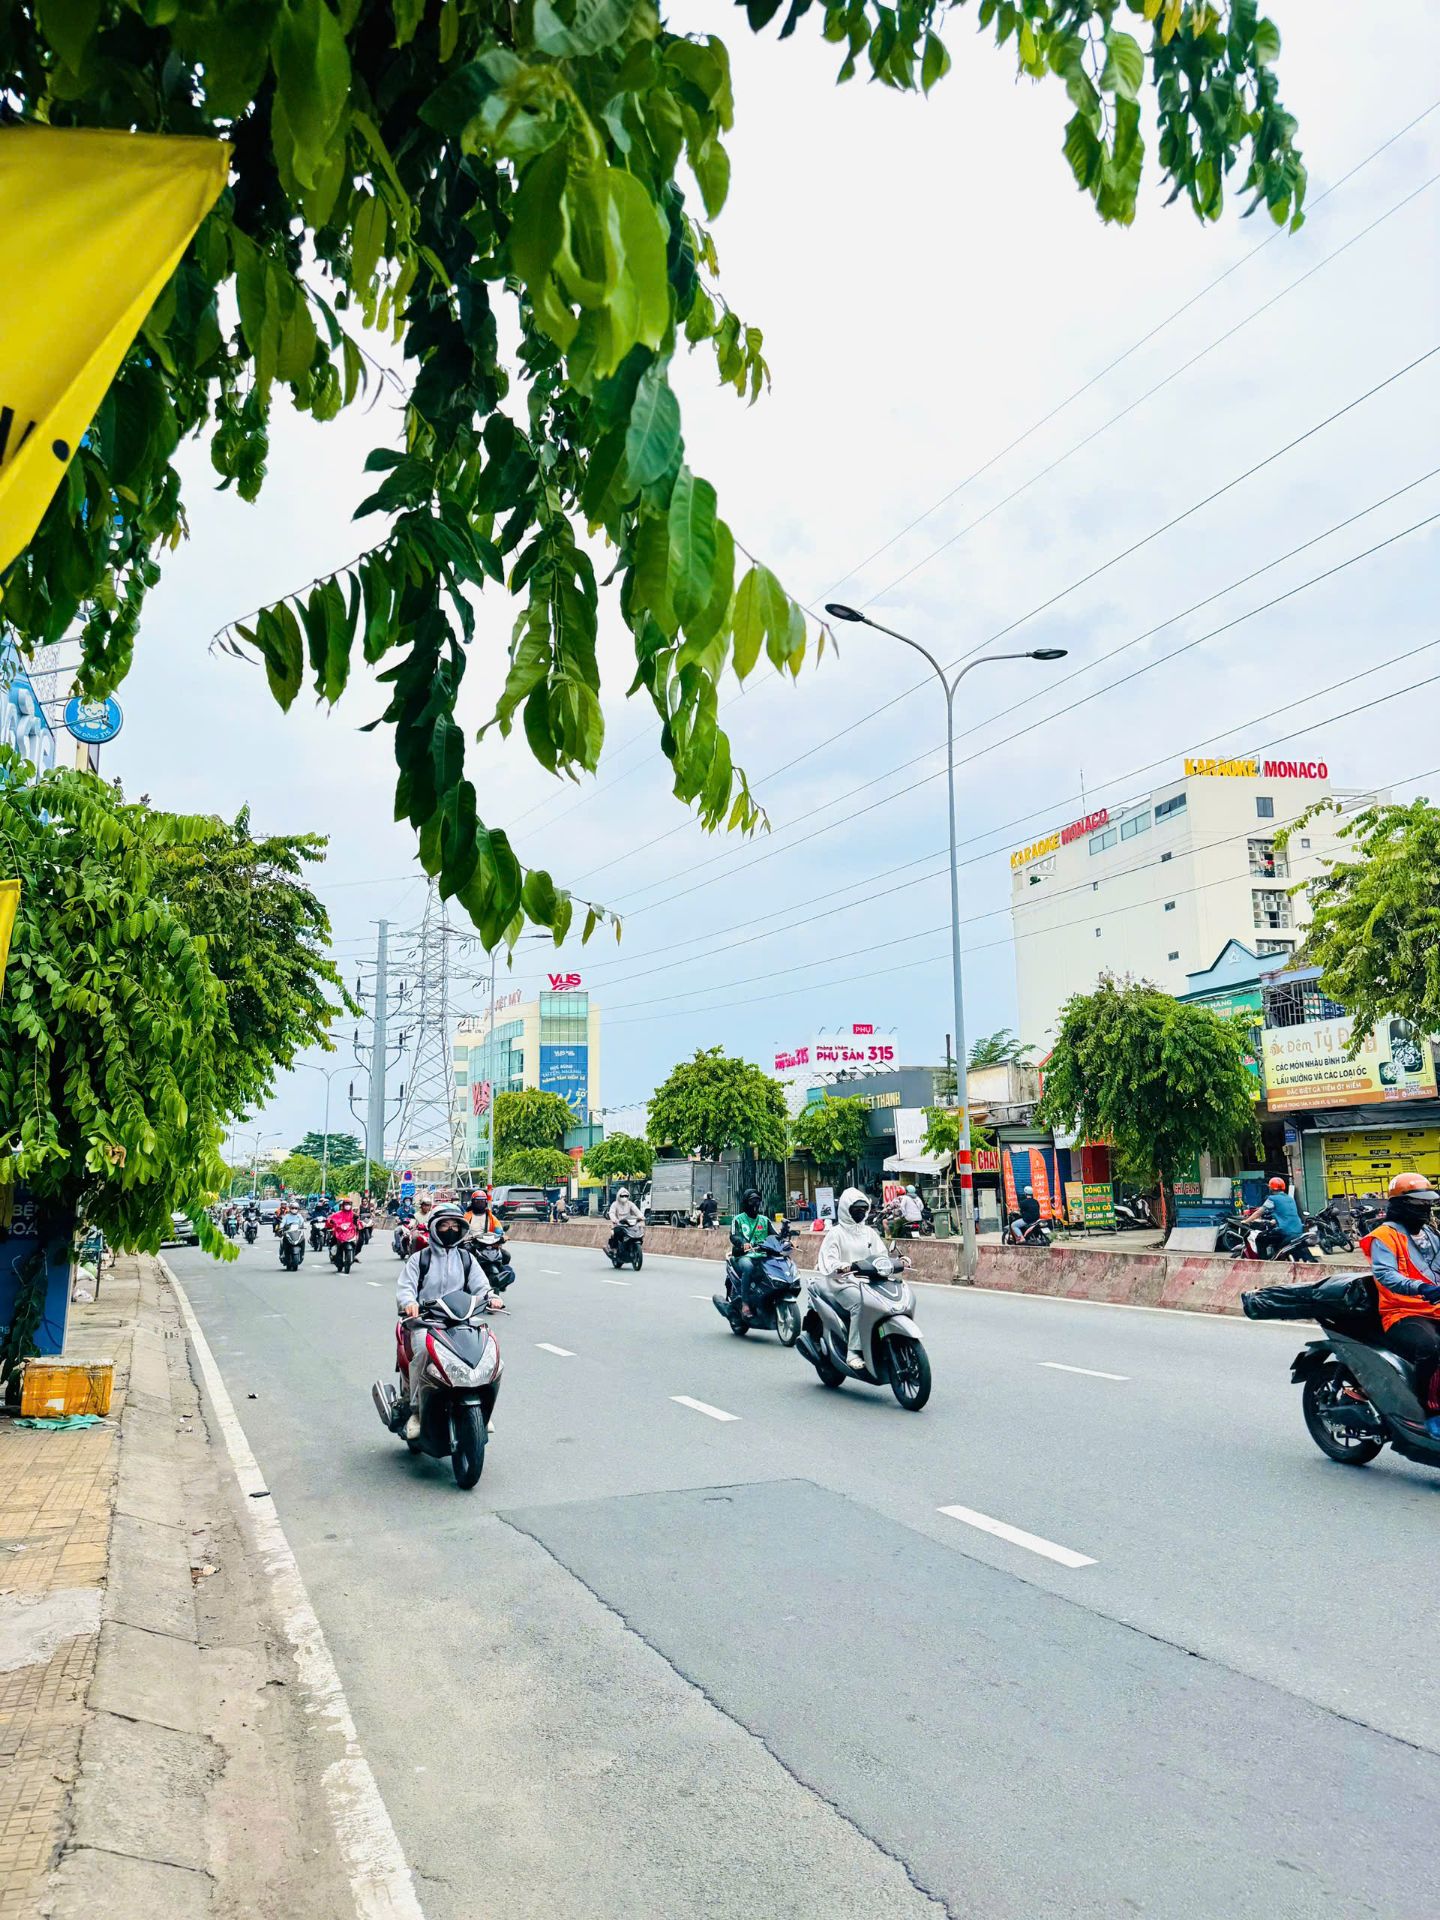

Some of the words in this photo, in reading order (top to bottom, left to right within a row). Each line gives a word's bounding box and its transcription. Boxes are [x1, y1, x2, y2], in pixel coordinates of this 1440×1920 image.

[1184, 758, 1257, 777] KARAOKE
[1263, 760, 1328, 779] MONACO
[1010, 832, 1060, 868] KARAOKE
[1061, 808, 1108, 846] MONACO
[547, 973, 582, 988] VUS
[855, 1026, 871, 1034] PHỤ
[816, 1051, 839, 1062] PHỤ
[842, 1048, 864, 1060] SẢN
[868, 1046, 894, 1060] 315
[876, 1092, 900, 1109] THANH
[978, 1151, 998, 1169] CHAY
